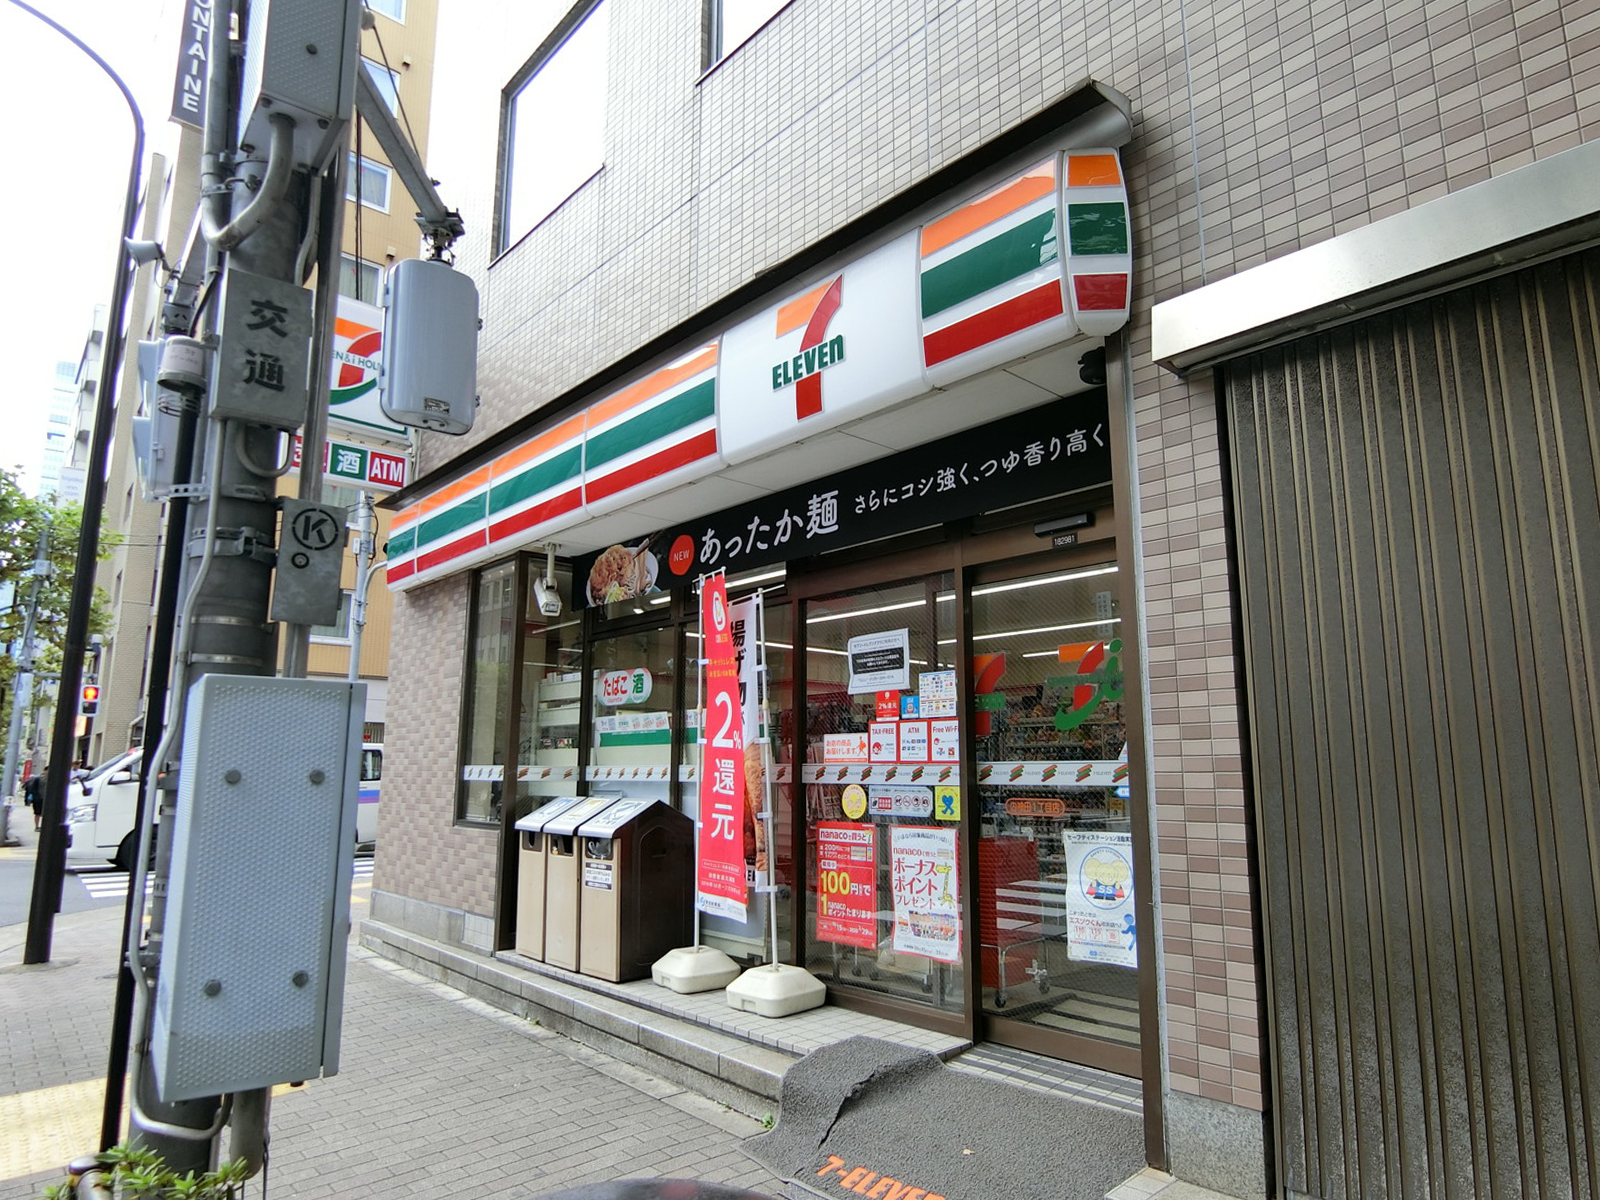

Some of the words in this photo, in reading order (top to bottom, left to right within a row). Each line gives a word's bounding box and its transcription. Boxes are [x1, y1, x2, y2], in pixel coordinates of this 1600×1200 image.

[243, 299, 288, 392] 交通
[337, 448, 362, 474] 酒
[371, 456, 403, 483] ATM
[855, 424, 1104, 513] さらにコシ強く、つゆ香り高く
[700, 490, 839, 564] あったか麺
[673, 549, 690, 562] NEW
[603, 675, 628, 697] たばこ
[893, 857, 938, 877] ボーナス
[894, 876, 938, 896] ポイント
[895, 894, 936, 910] プレゼント
